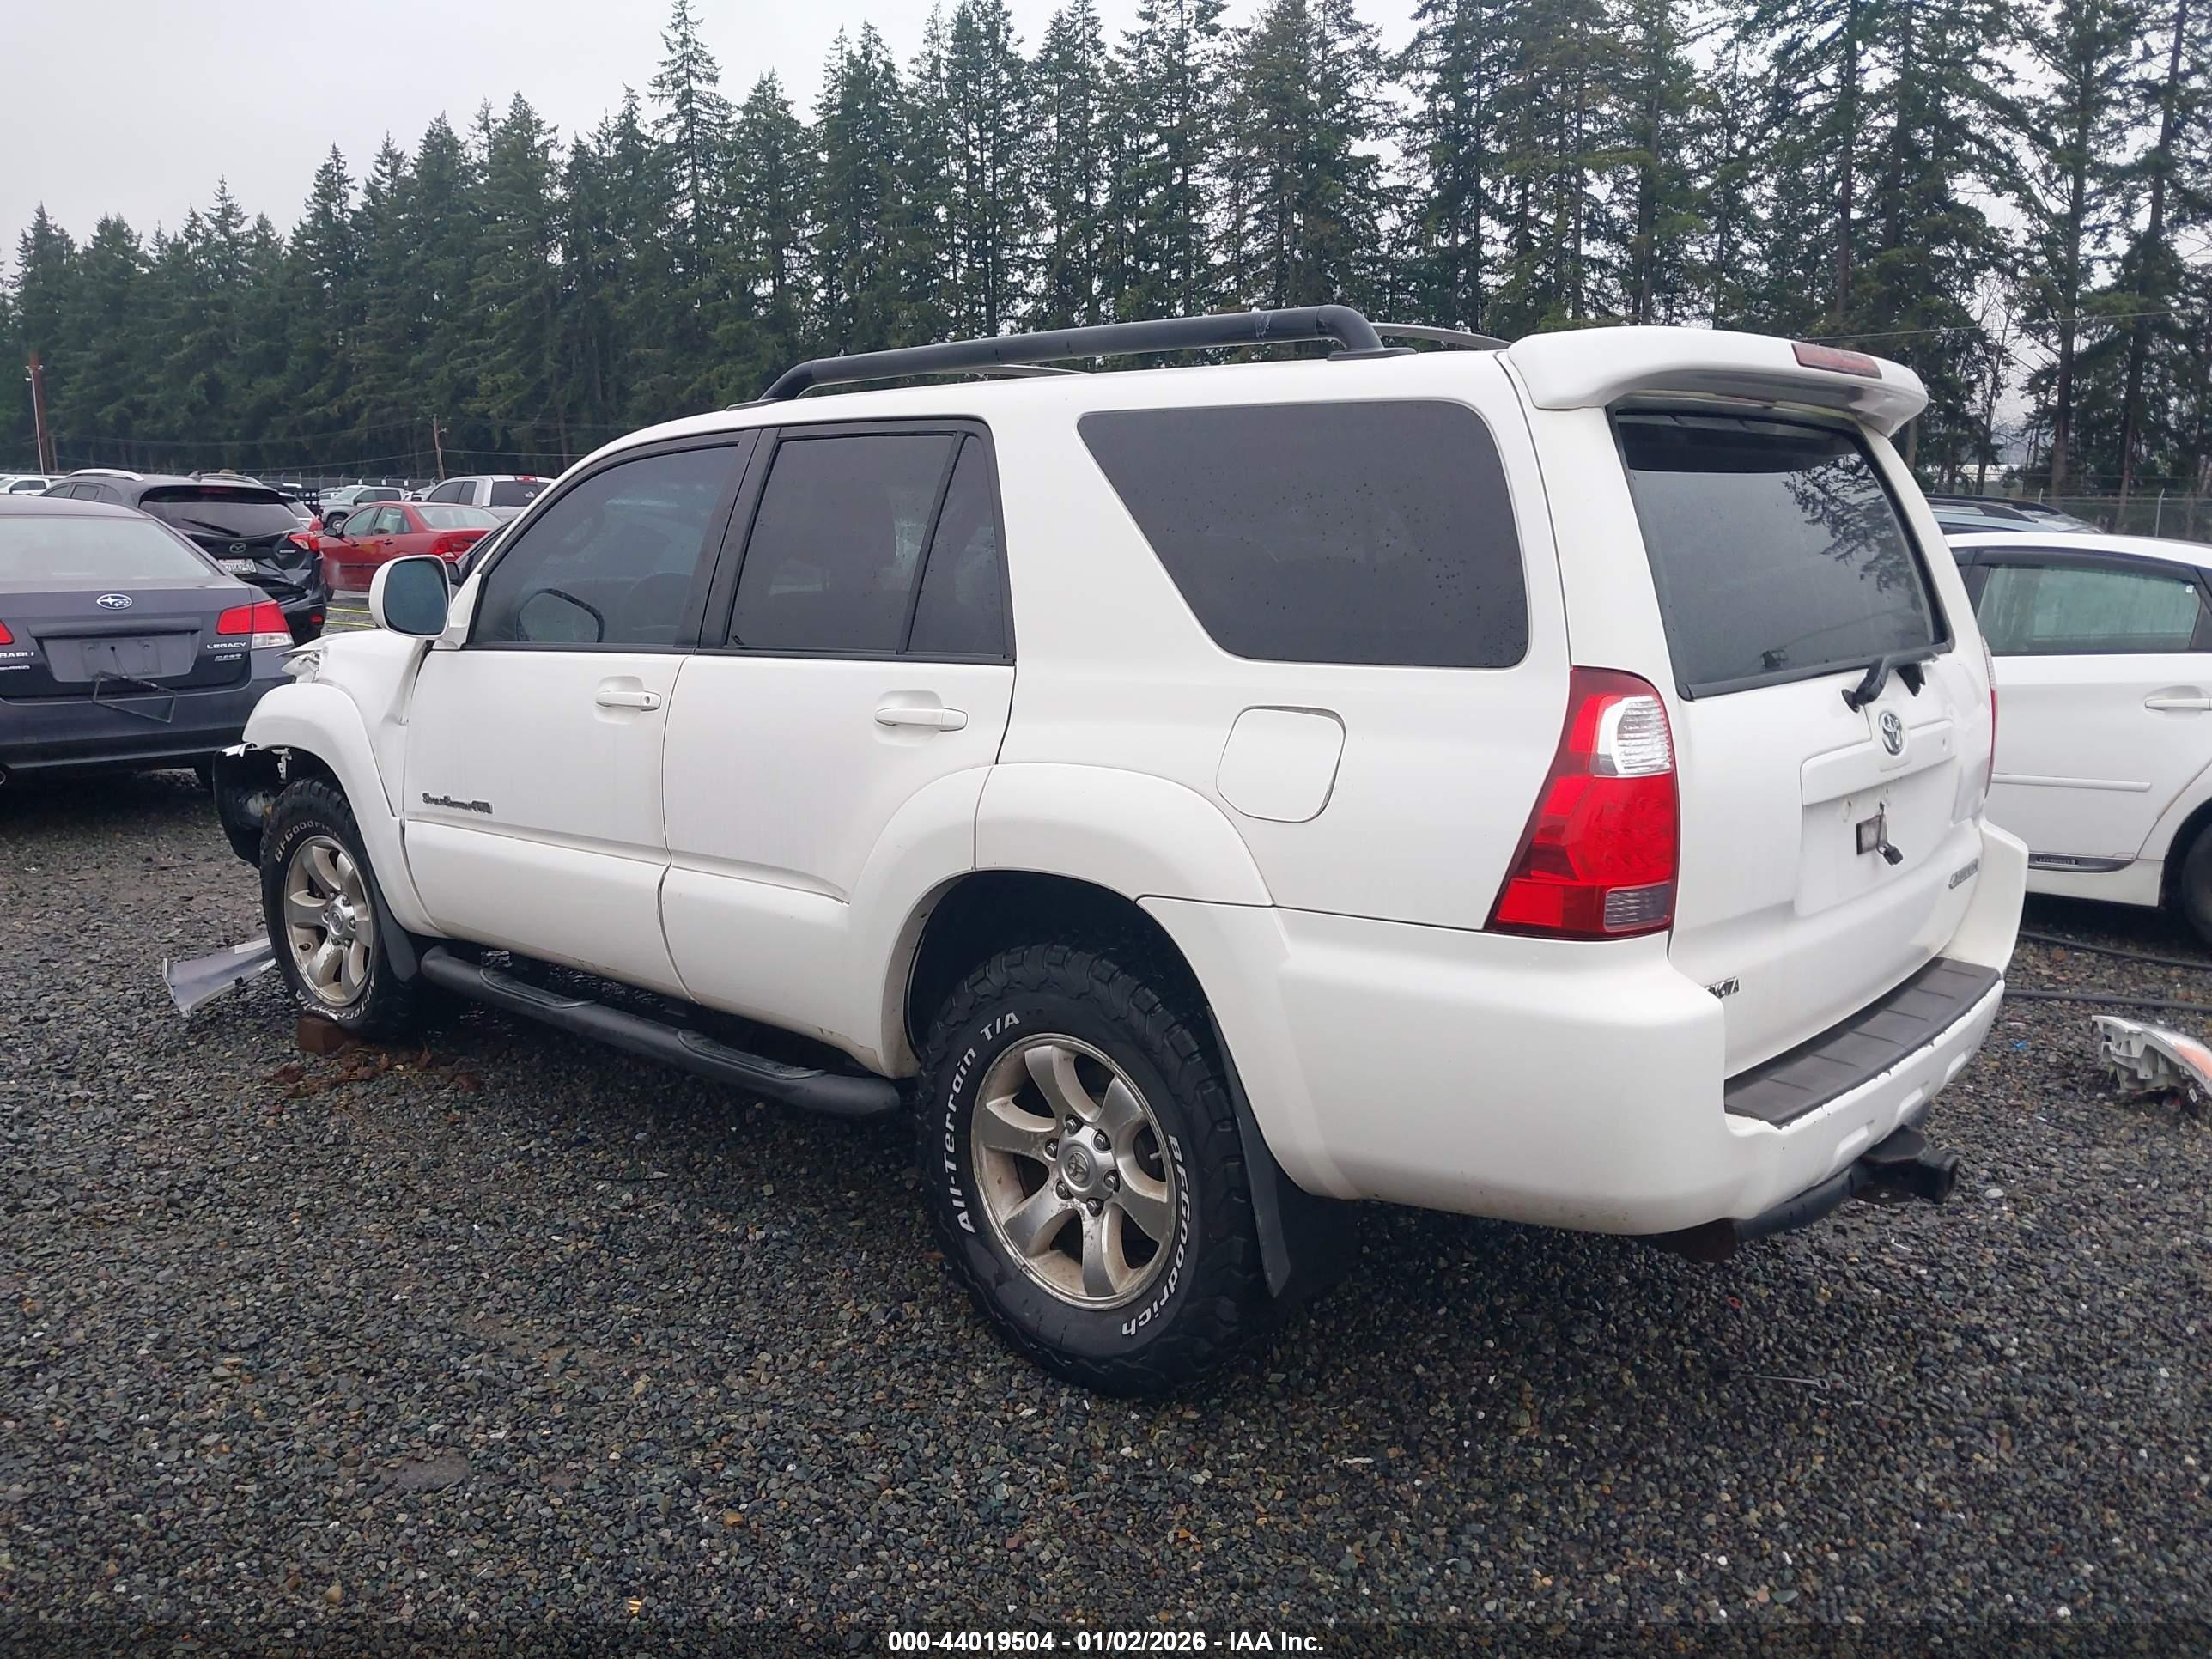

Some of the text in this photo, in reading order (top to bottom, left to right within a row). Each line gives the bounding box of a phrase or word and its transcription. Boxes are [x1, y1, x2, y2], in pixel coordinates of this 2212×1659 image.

[944, 1012, 1020, 1234] All-Terrain T/A
[1121, 1134, 1191, 1336] BFGoodrich
